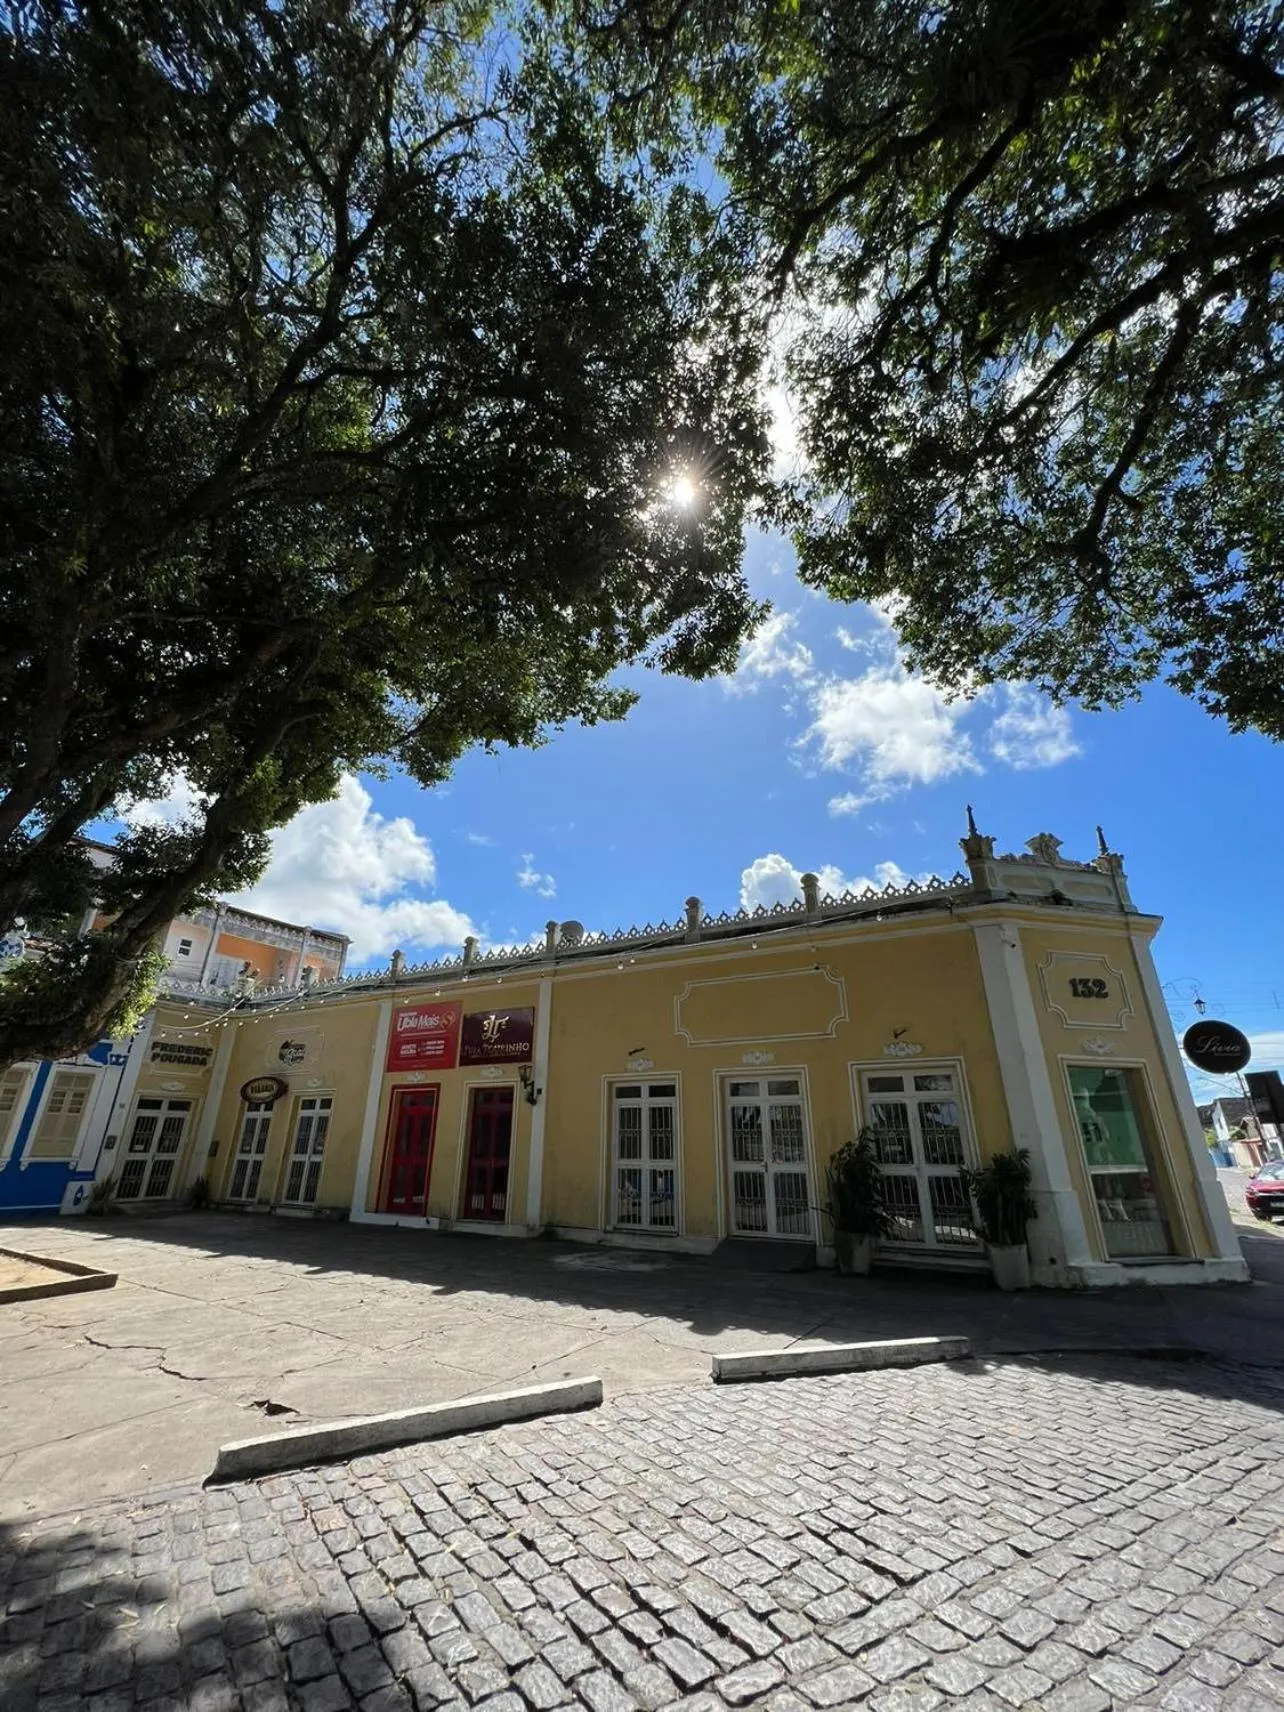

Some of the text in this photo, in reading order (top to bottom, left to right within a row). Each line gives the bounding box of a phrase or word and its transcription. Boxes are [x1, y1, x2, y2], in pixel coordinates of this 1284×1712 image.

[1069, 978, 1108, 999] 132
[418, 1013, 440, 1027] Mais
[151, 1041, 213, 1056] FREDERIC
